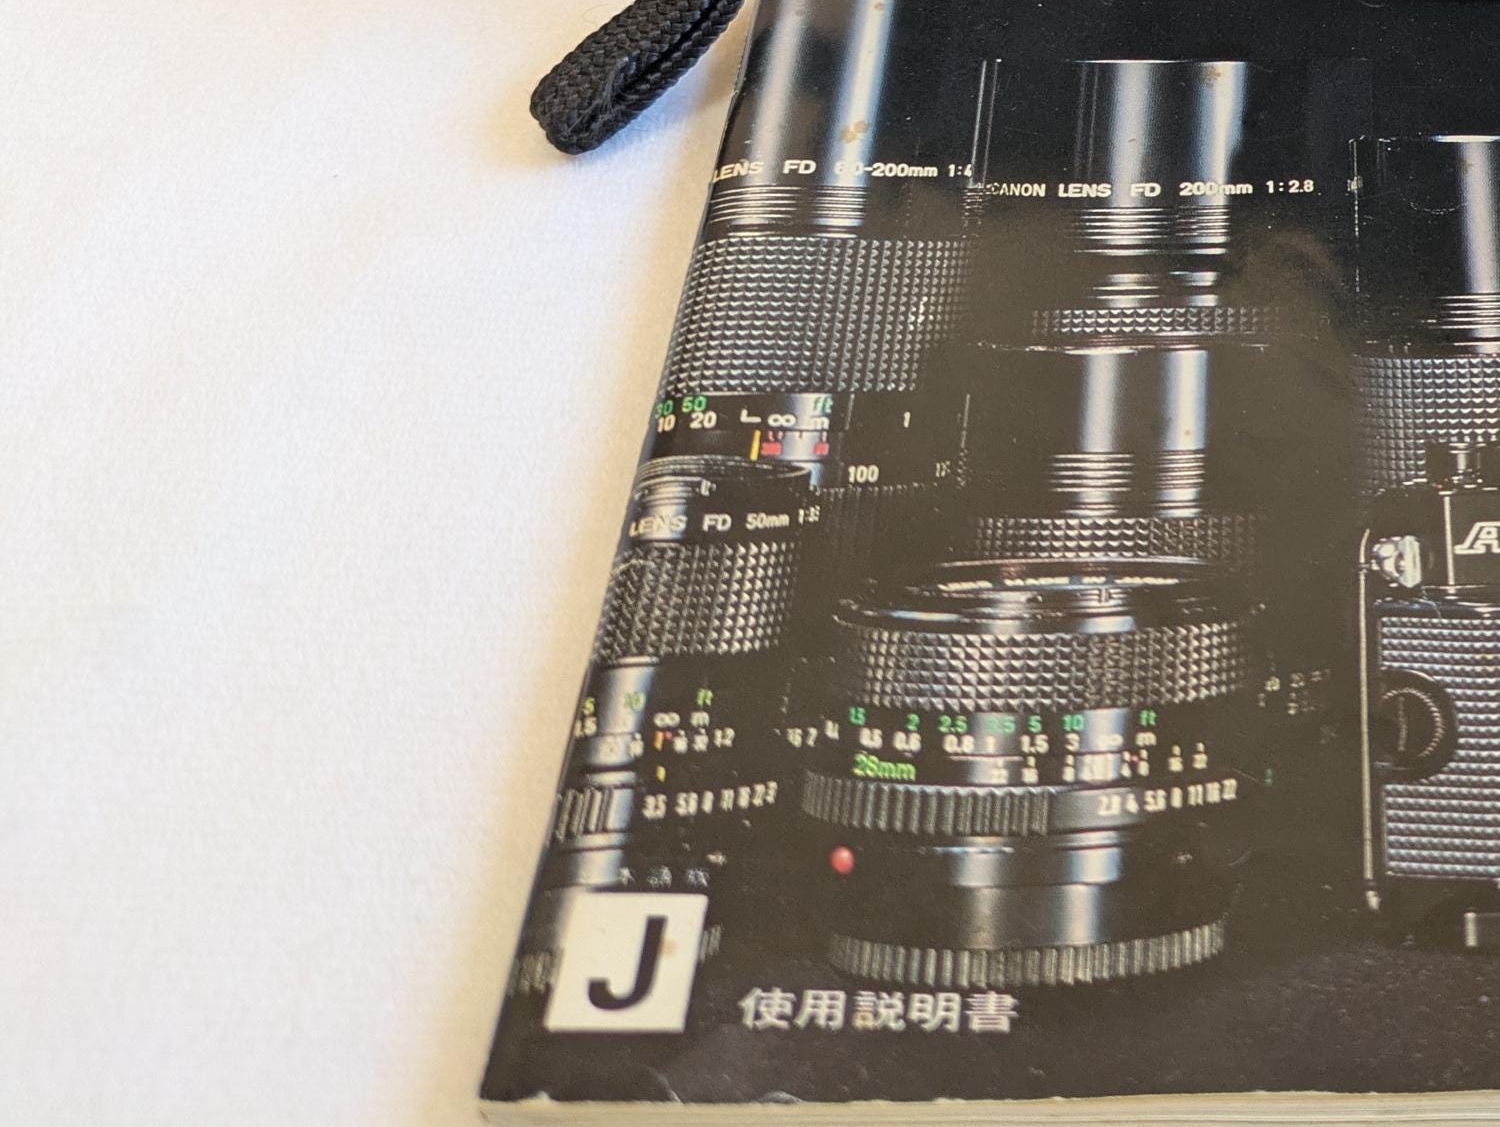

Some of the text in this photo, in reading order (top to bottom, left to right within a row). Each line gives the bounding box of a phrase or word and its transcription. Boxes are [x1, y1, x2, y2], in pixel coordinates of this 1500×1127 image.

[713, 159, 764, 183] LENS
[782, 160, 817, 174] FD
[988, 182, 1046, 197] CANON
[1057, 182, 1112, 197] LENS
[1130, 182, 1161, 197] FD
[1179, 182, 1253, 196] 200mm
[682, 396, 706, 413] 50
[690, 411, 717, 429] 20
[848, 464, 880, 484] 100
[702, 513, 732, 532] FD
[588, 915, 668, 1011] J
[738, 986, 1019, 1034] 使用説明書
